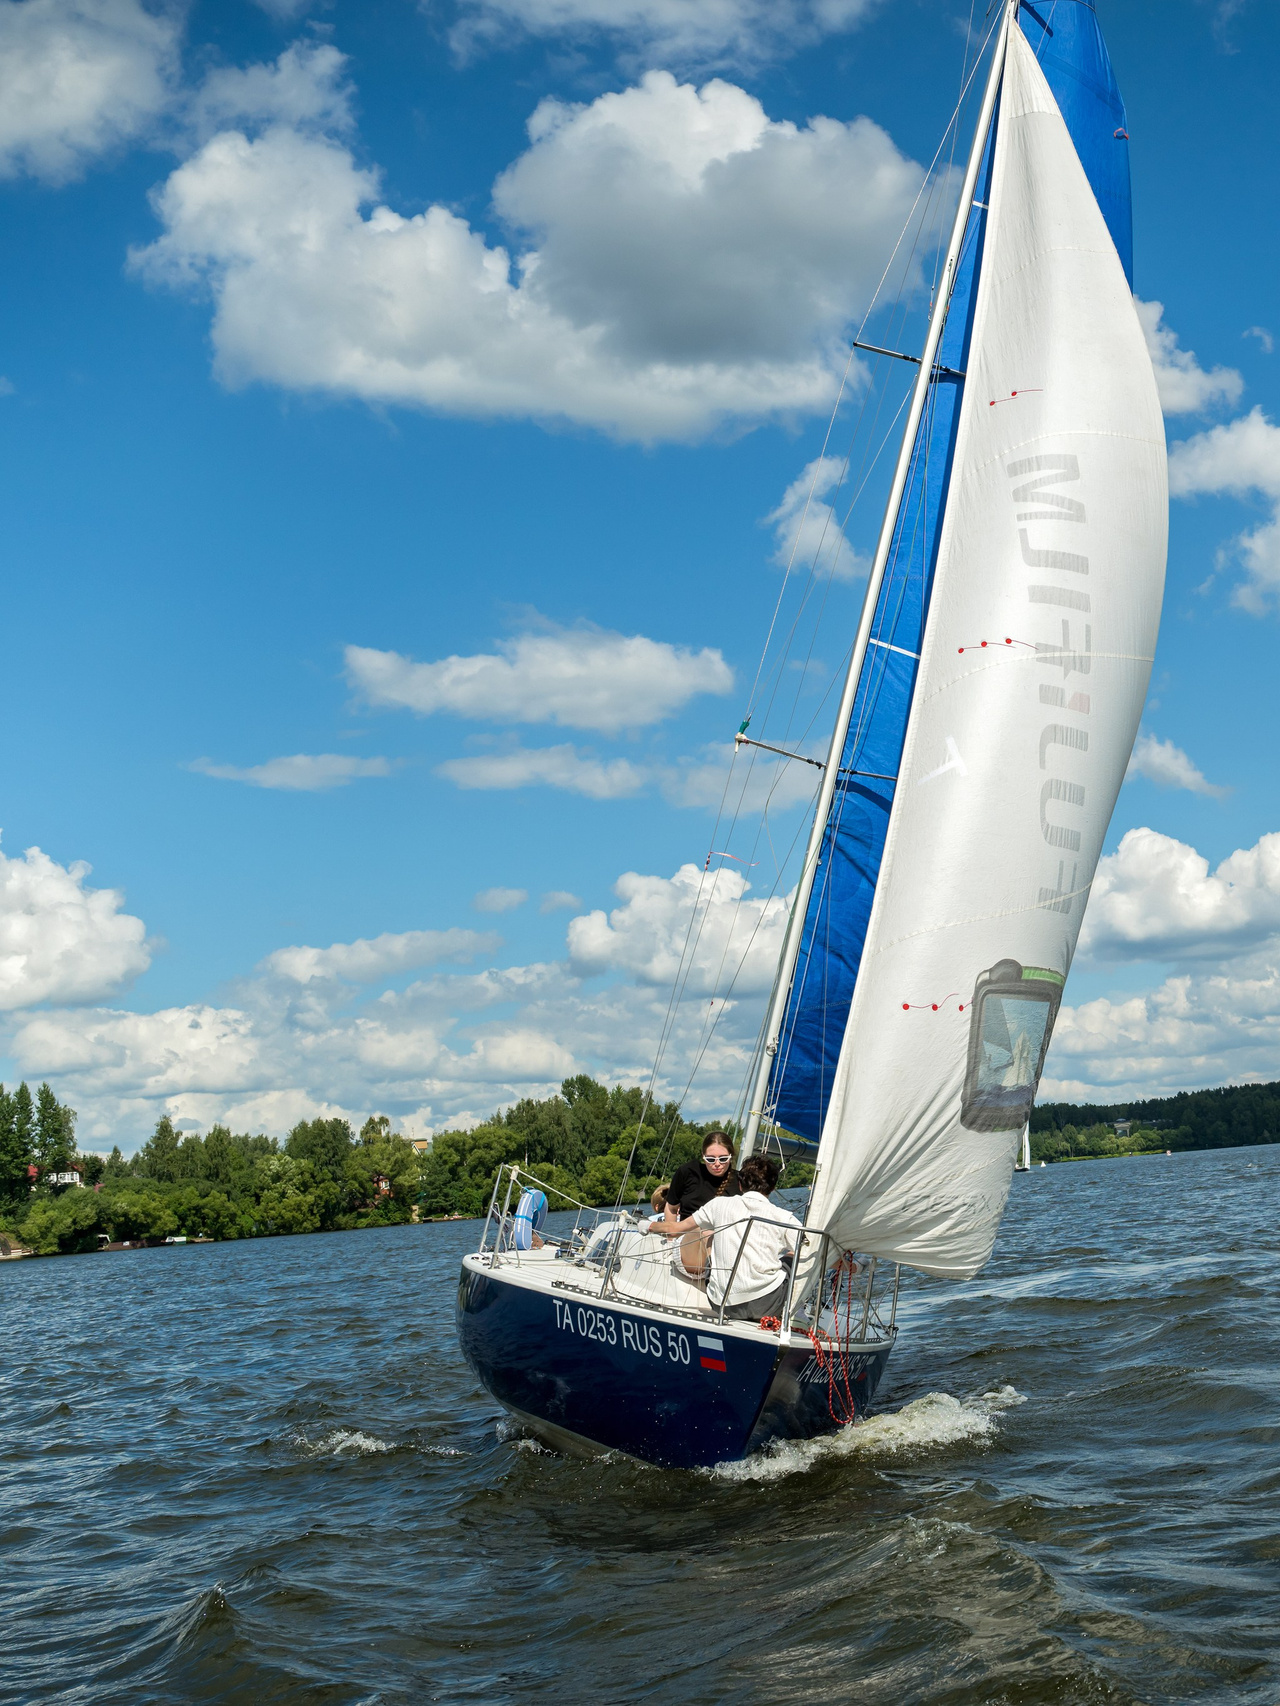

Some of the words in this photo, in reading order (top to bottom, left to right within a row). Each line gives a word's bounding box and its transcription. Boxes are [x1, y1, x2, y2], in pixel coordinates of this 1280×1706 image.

[552, 1298, 575, 1333] TA
[577, 1307, 617, 1345] 0253
[621, 1318, 663, 1358] RUS
[667, 1331, 691, 1365] 50
